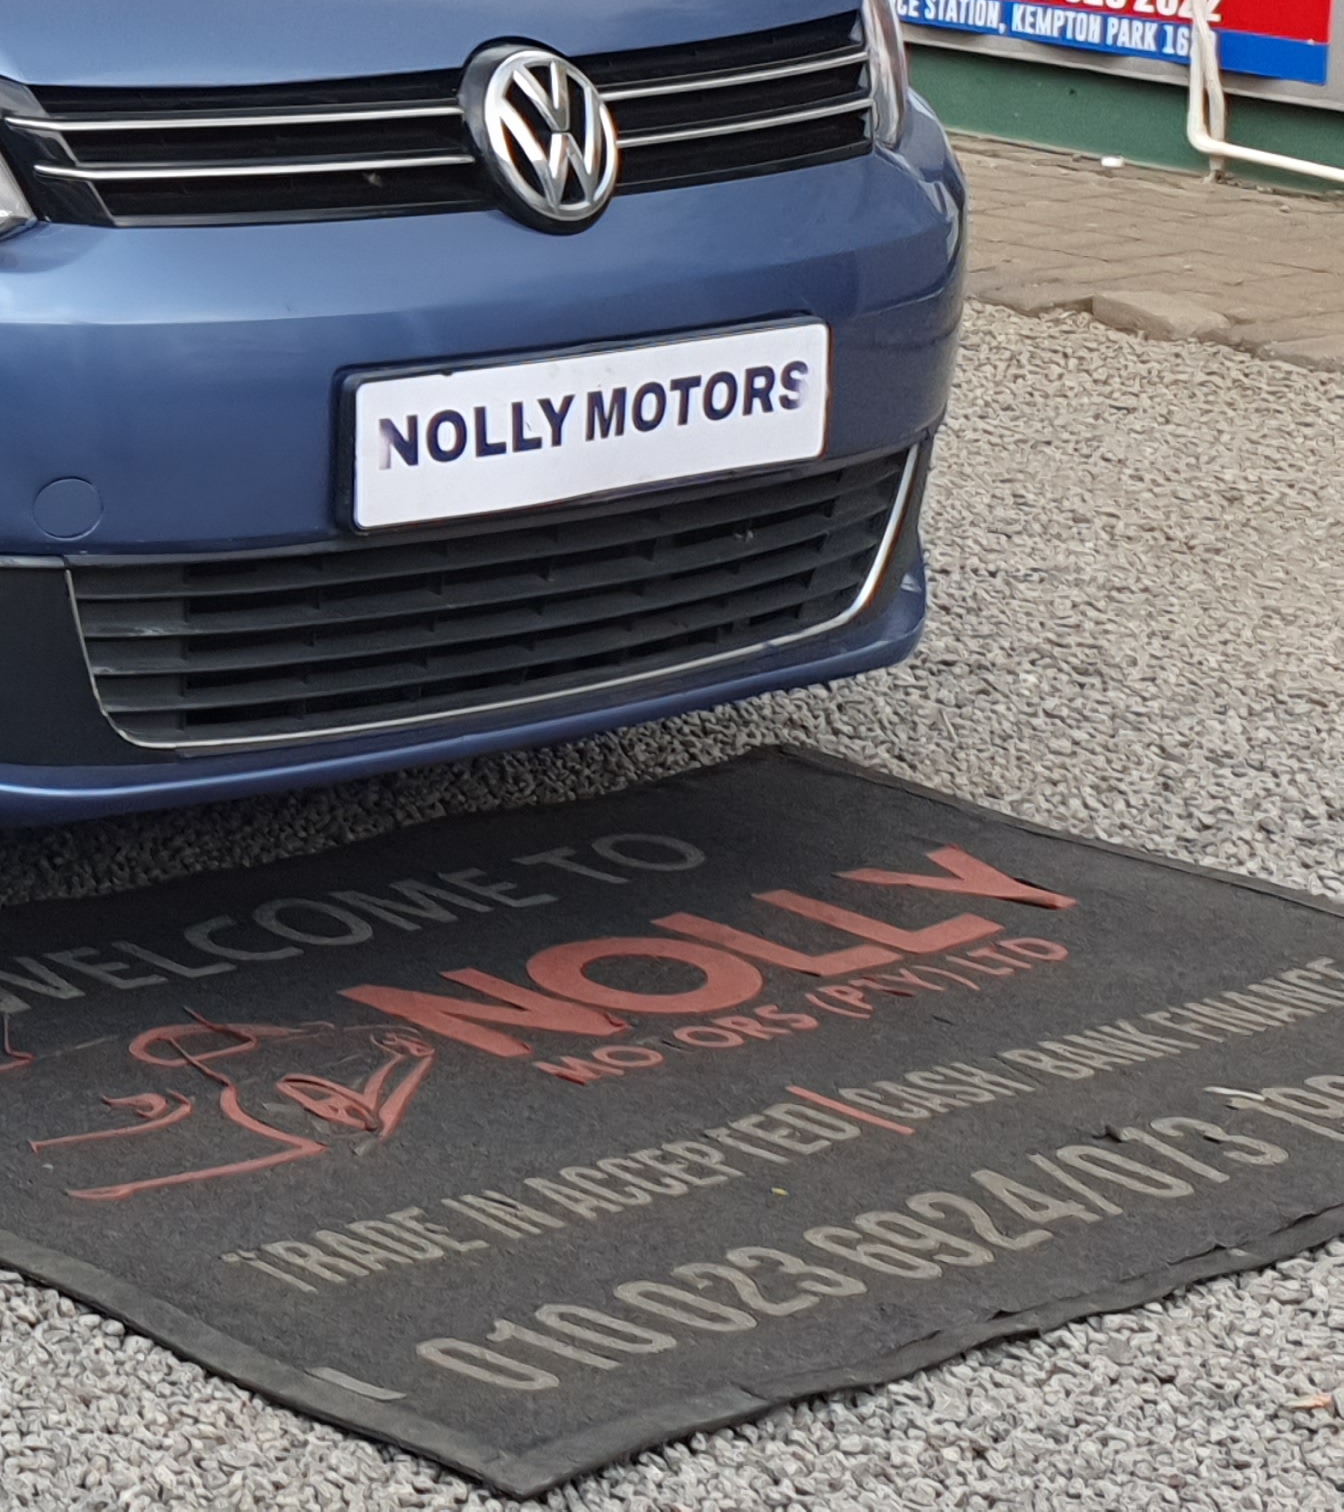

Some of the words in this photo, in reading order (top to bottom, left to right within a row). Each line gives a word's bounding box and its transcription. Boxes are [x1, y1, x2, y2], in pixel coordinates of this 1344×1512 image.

[1011, 2, 1103, 44] KEMPTON
[1106, 17, 1159, 52] PARK
[378, 394, 575, 470] NOLLY
[585, 359, 810, 442] MOTORS
[517, 833, 707, 884] TO
[335, 843, 1078, 1058] NOLLY
[533, 1003, 820, 1086] MOORS
[945, 937, 1069, 977] LTD
[222, 1206, 490, 1293] TRADE
[442, 1189, 566, 1239] IN
[524, 1101, 863, 1220] ACCEPTED
[1002, 1019, 1201, 1080] BANK
[415, 1303, 678, 1390] 010
[613, 1246, 869, 1333] 023
